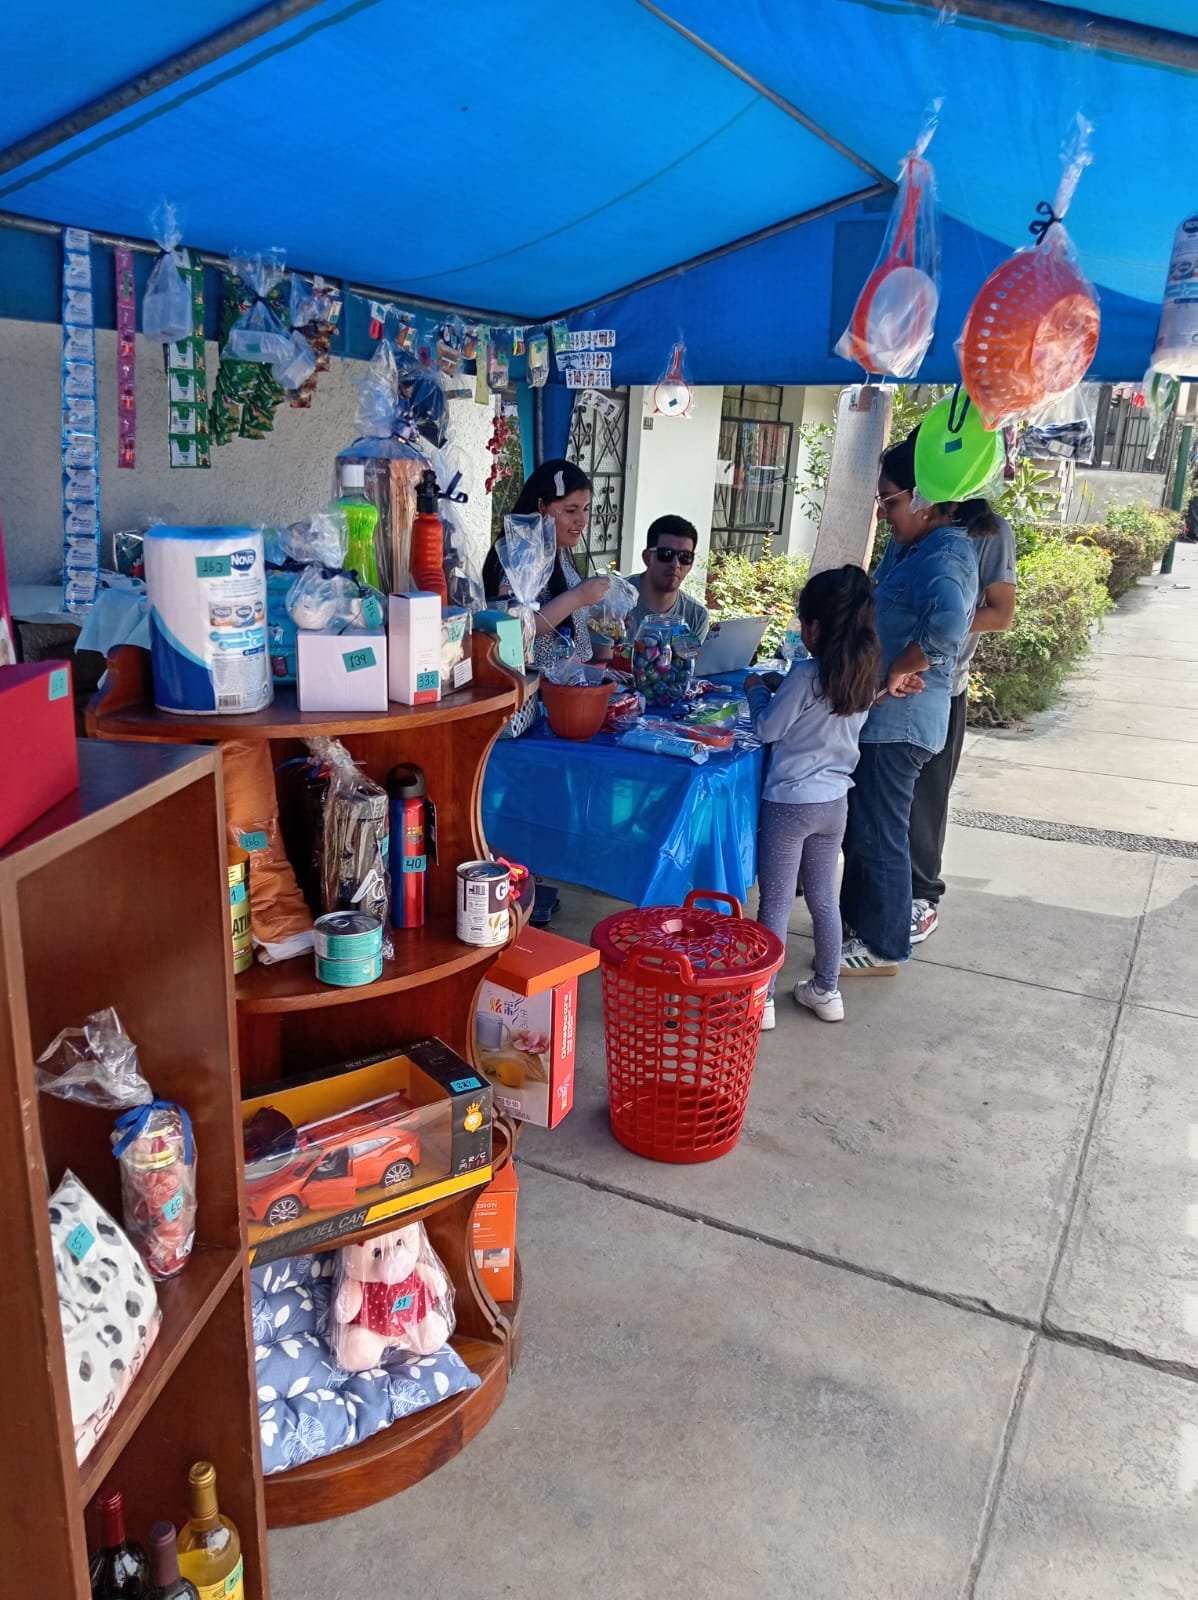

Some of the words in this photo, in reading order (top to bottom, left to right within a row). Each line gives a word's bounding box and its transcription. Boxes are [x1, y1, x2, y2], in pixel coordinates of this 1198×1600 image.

[203, 560, 224, 573] 163
[350, 654, 367, 668] 139
[406, 857, 422, 869] 40
[290, 1221, 336, 1250] MODEL
[339, 1209, 367, 1229] CAR
